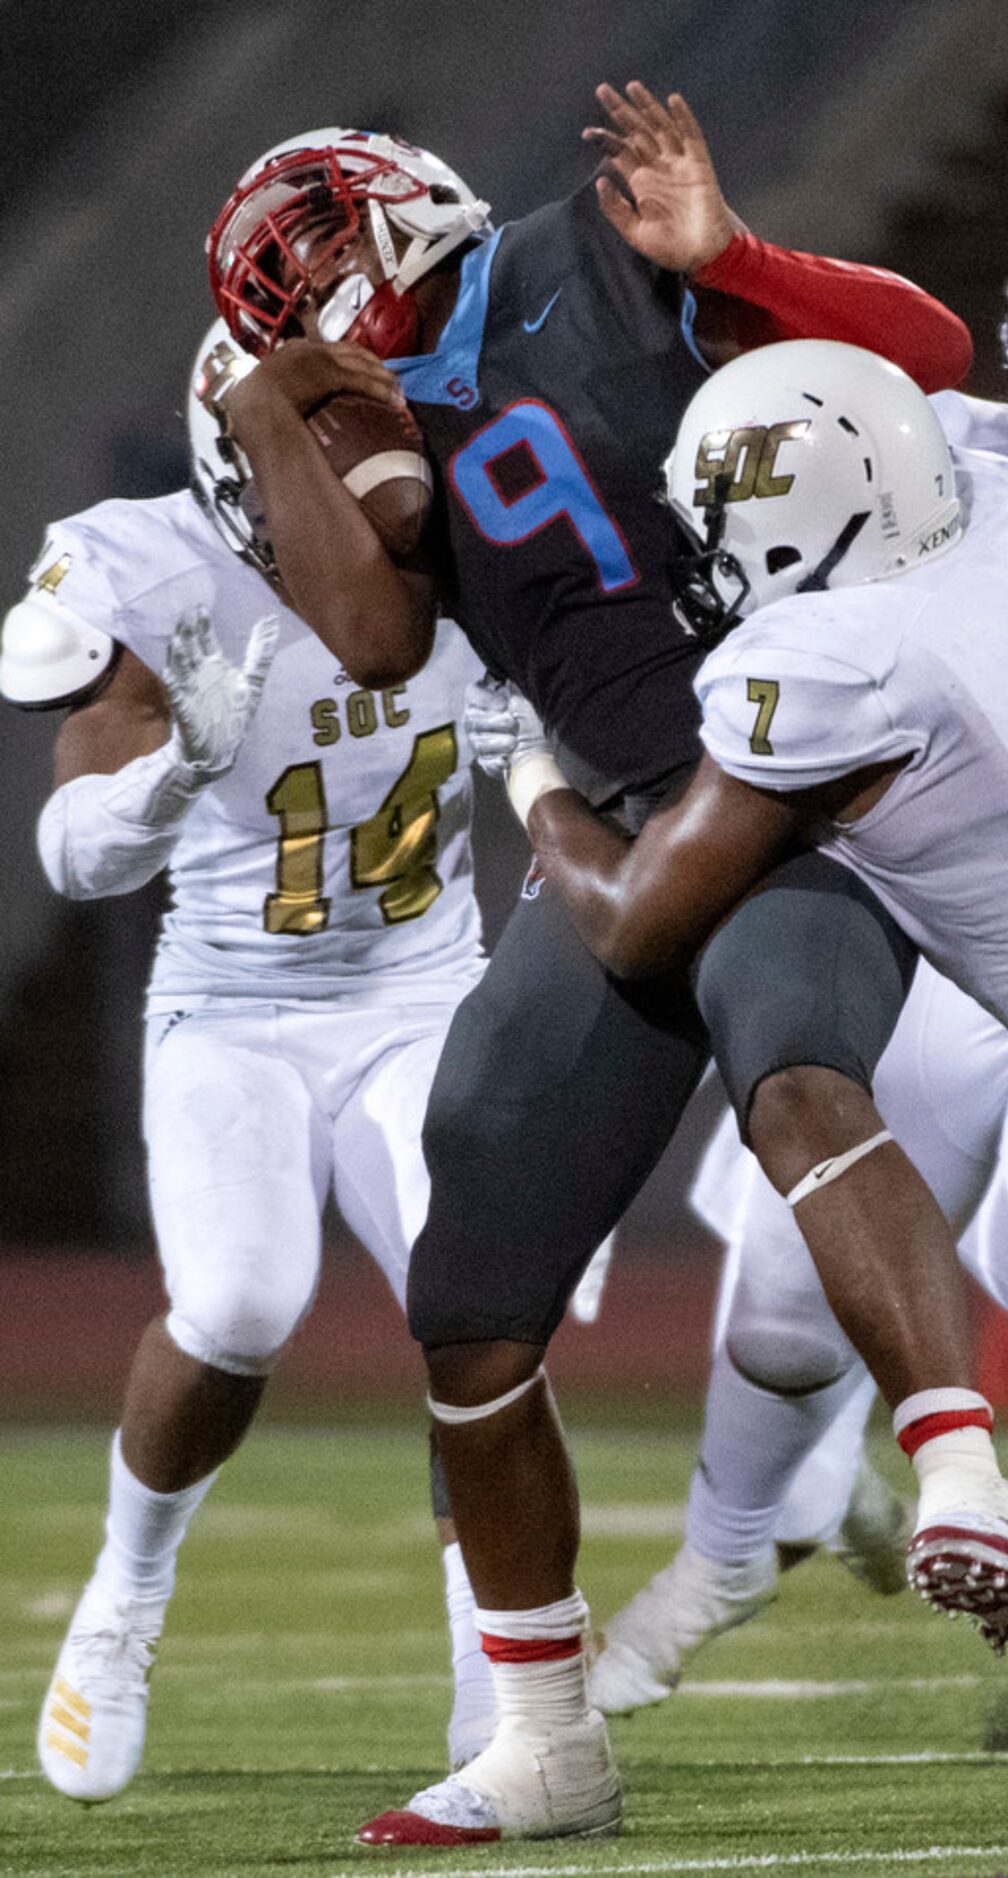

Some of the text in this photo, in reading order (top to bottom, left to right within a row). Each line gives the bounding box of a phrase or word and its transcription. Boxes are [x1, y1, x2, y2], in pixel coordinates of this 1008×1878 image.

[449, 396, 640, 593] 9
[692, 419, 812, 507] SOC
[310, 682, 410, 747] SOC
[746, 677, 780, 757] 7
[264, 721, 459, 937] 14
